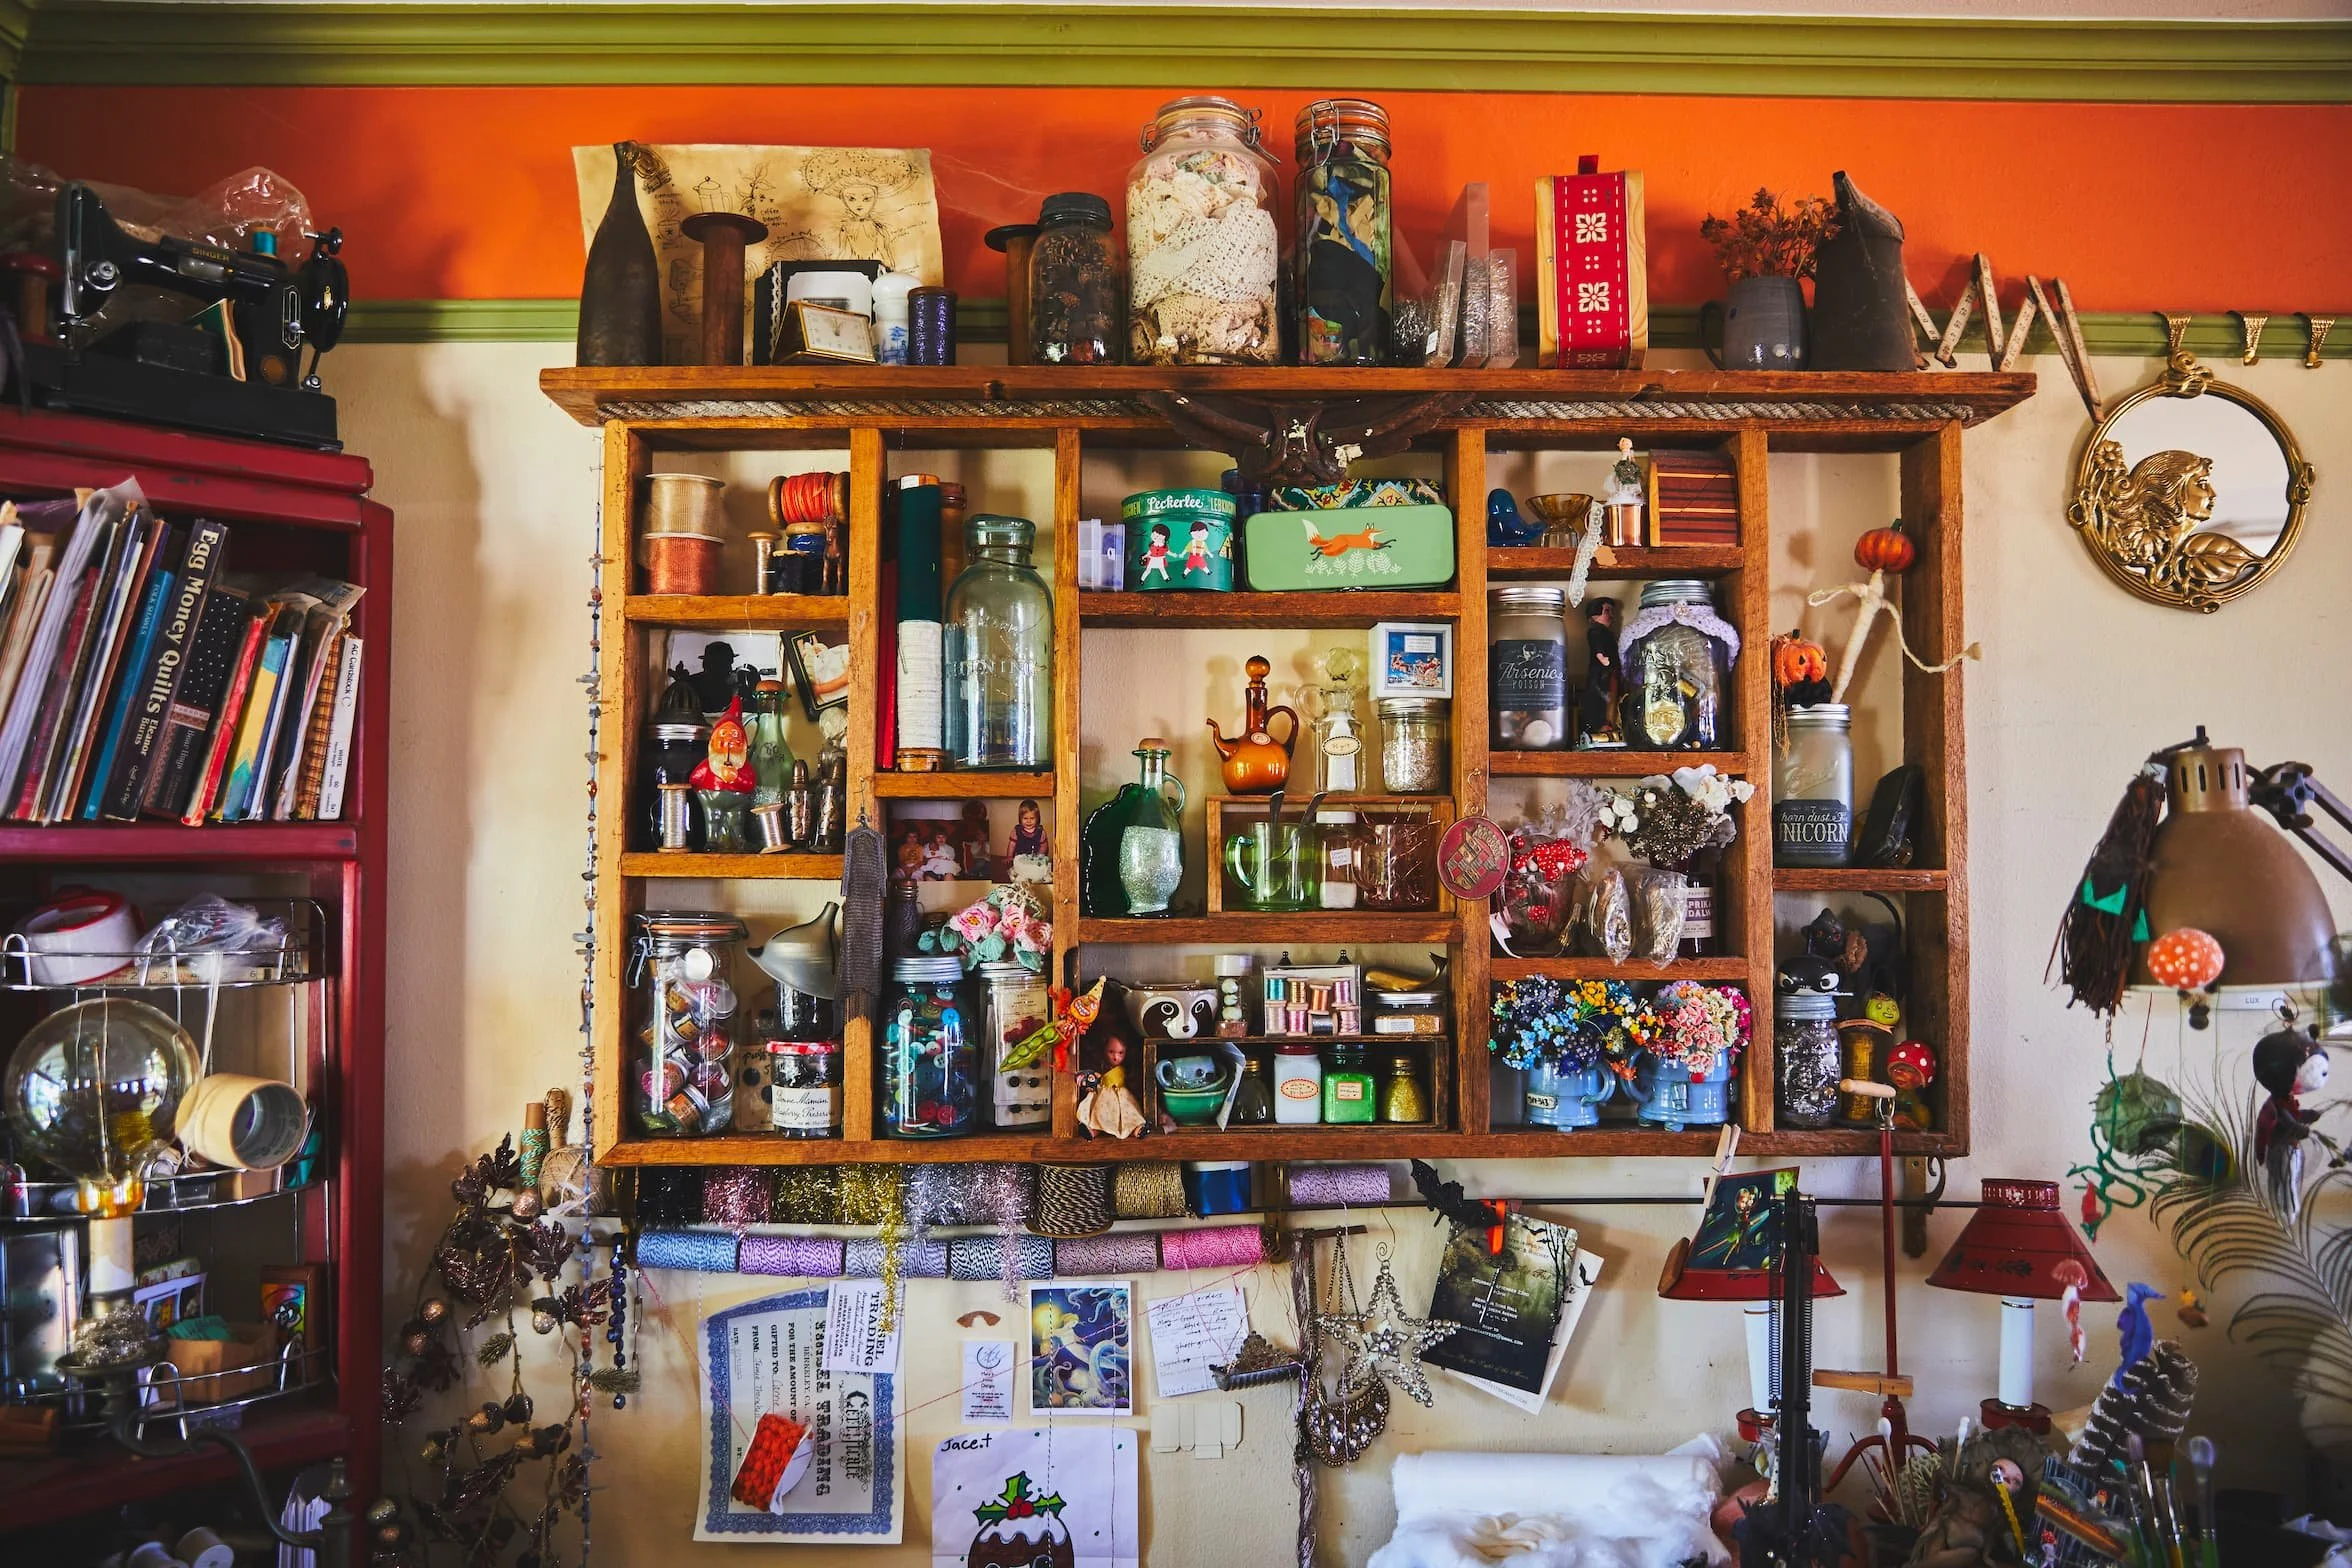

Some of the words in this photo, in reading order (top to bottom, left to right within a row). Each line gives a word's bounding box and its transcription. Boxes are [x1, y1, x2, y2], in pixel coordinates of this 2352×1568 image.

[1146, 494, 1204, 513] Leckerlee
[188, 528, 219, 571] Egg
[166, 576, 204, 646] Money
[146, 648, 180, 714] Quilts
[344, 657, 357, 694] Cardstock
[1498, 662, 1566, 682] Arsenic
[1512, 680, 1544, 689] POISON
[134, 716, 150, 746] Burns
[140, 718, 159, 757] Eleanor
[1781, 812, 1805, 822] horn
[1807, 811, 1832, 822] dust
[162, 971, 168, 980] 3
[864, 1292, 880, 1367] TRADING
[816, 1400, 830, 1496] TRADING
[841, 1390, 870, 1480] Certificate
